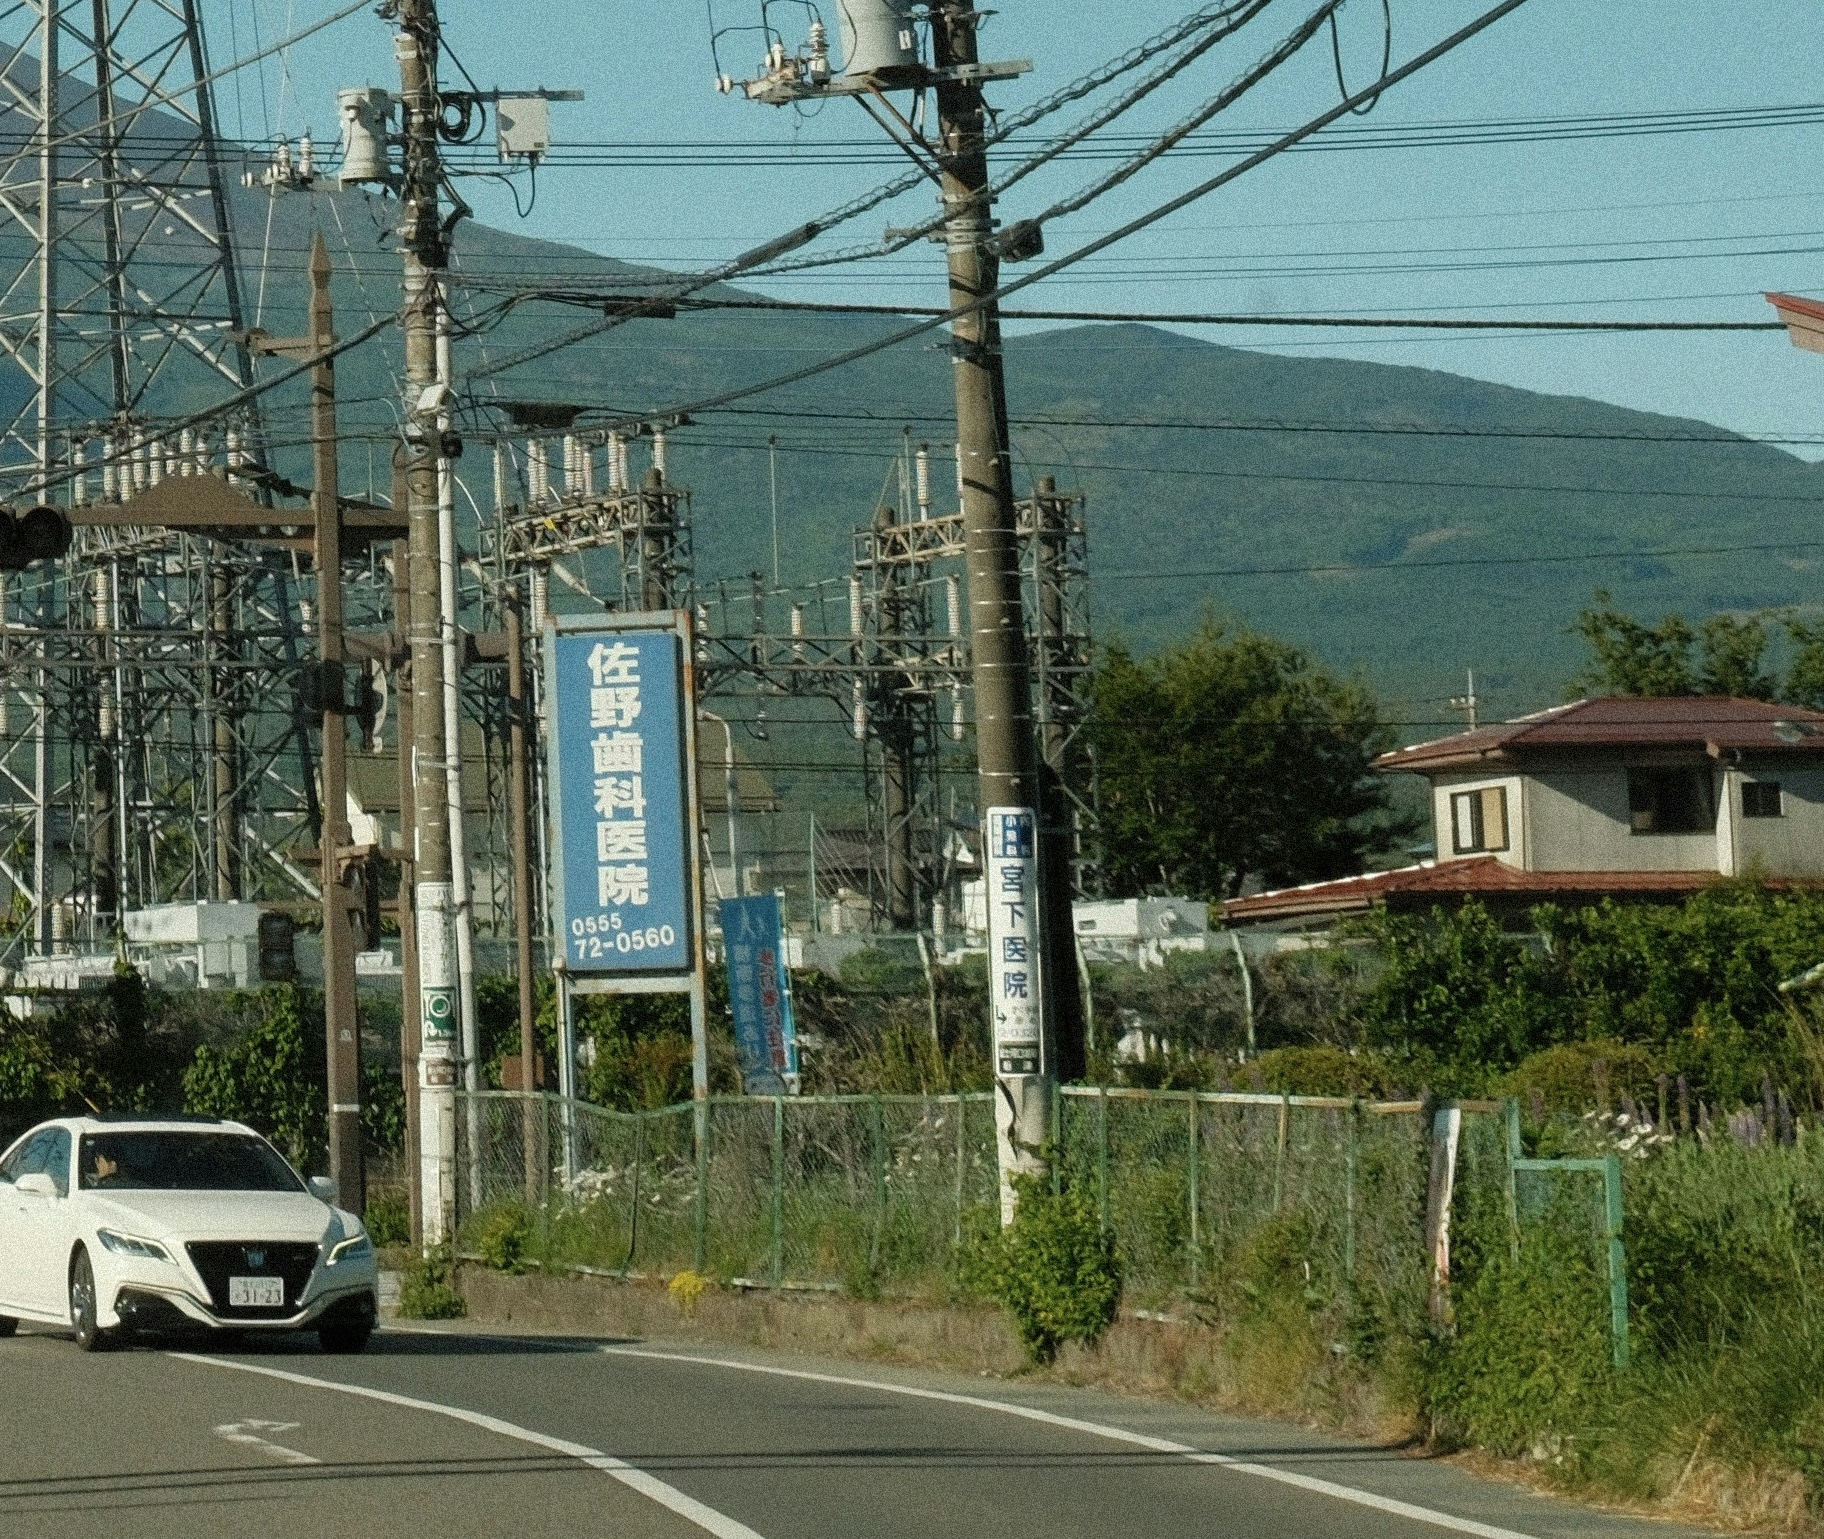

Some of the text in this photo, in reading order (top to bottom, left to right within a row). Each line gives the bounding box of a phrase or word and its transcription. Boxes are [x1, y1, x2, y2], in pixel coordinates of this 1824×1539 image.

[586, 642, 649, 906] 佐野歯科医院
[571, 912, 622, 936] 0555
[574, 925, 675, 959] 72-0560
[1000, 865, 1028, 999] 宮下医院
